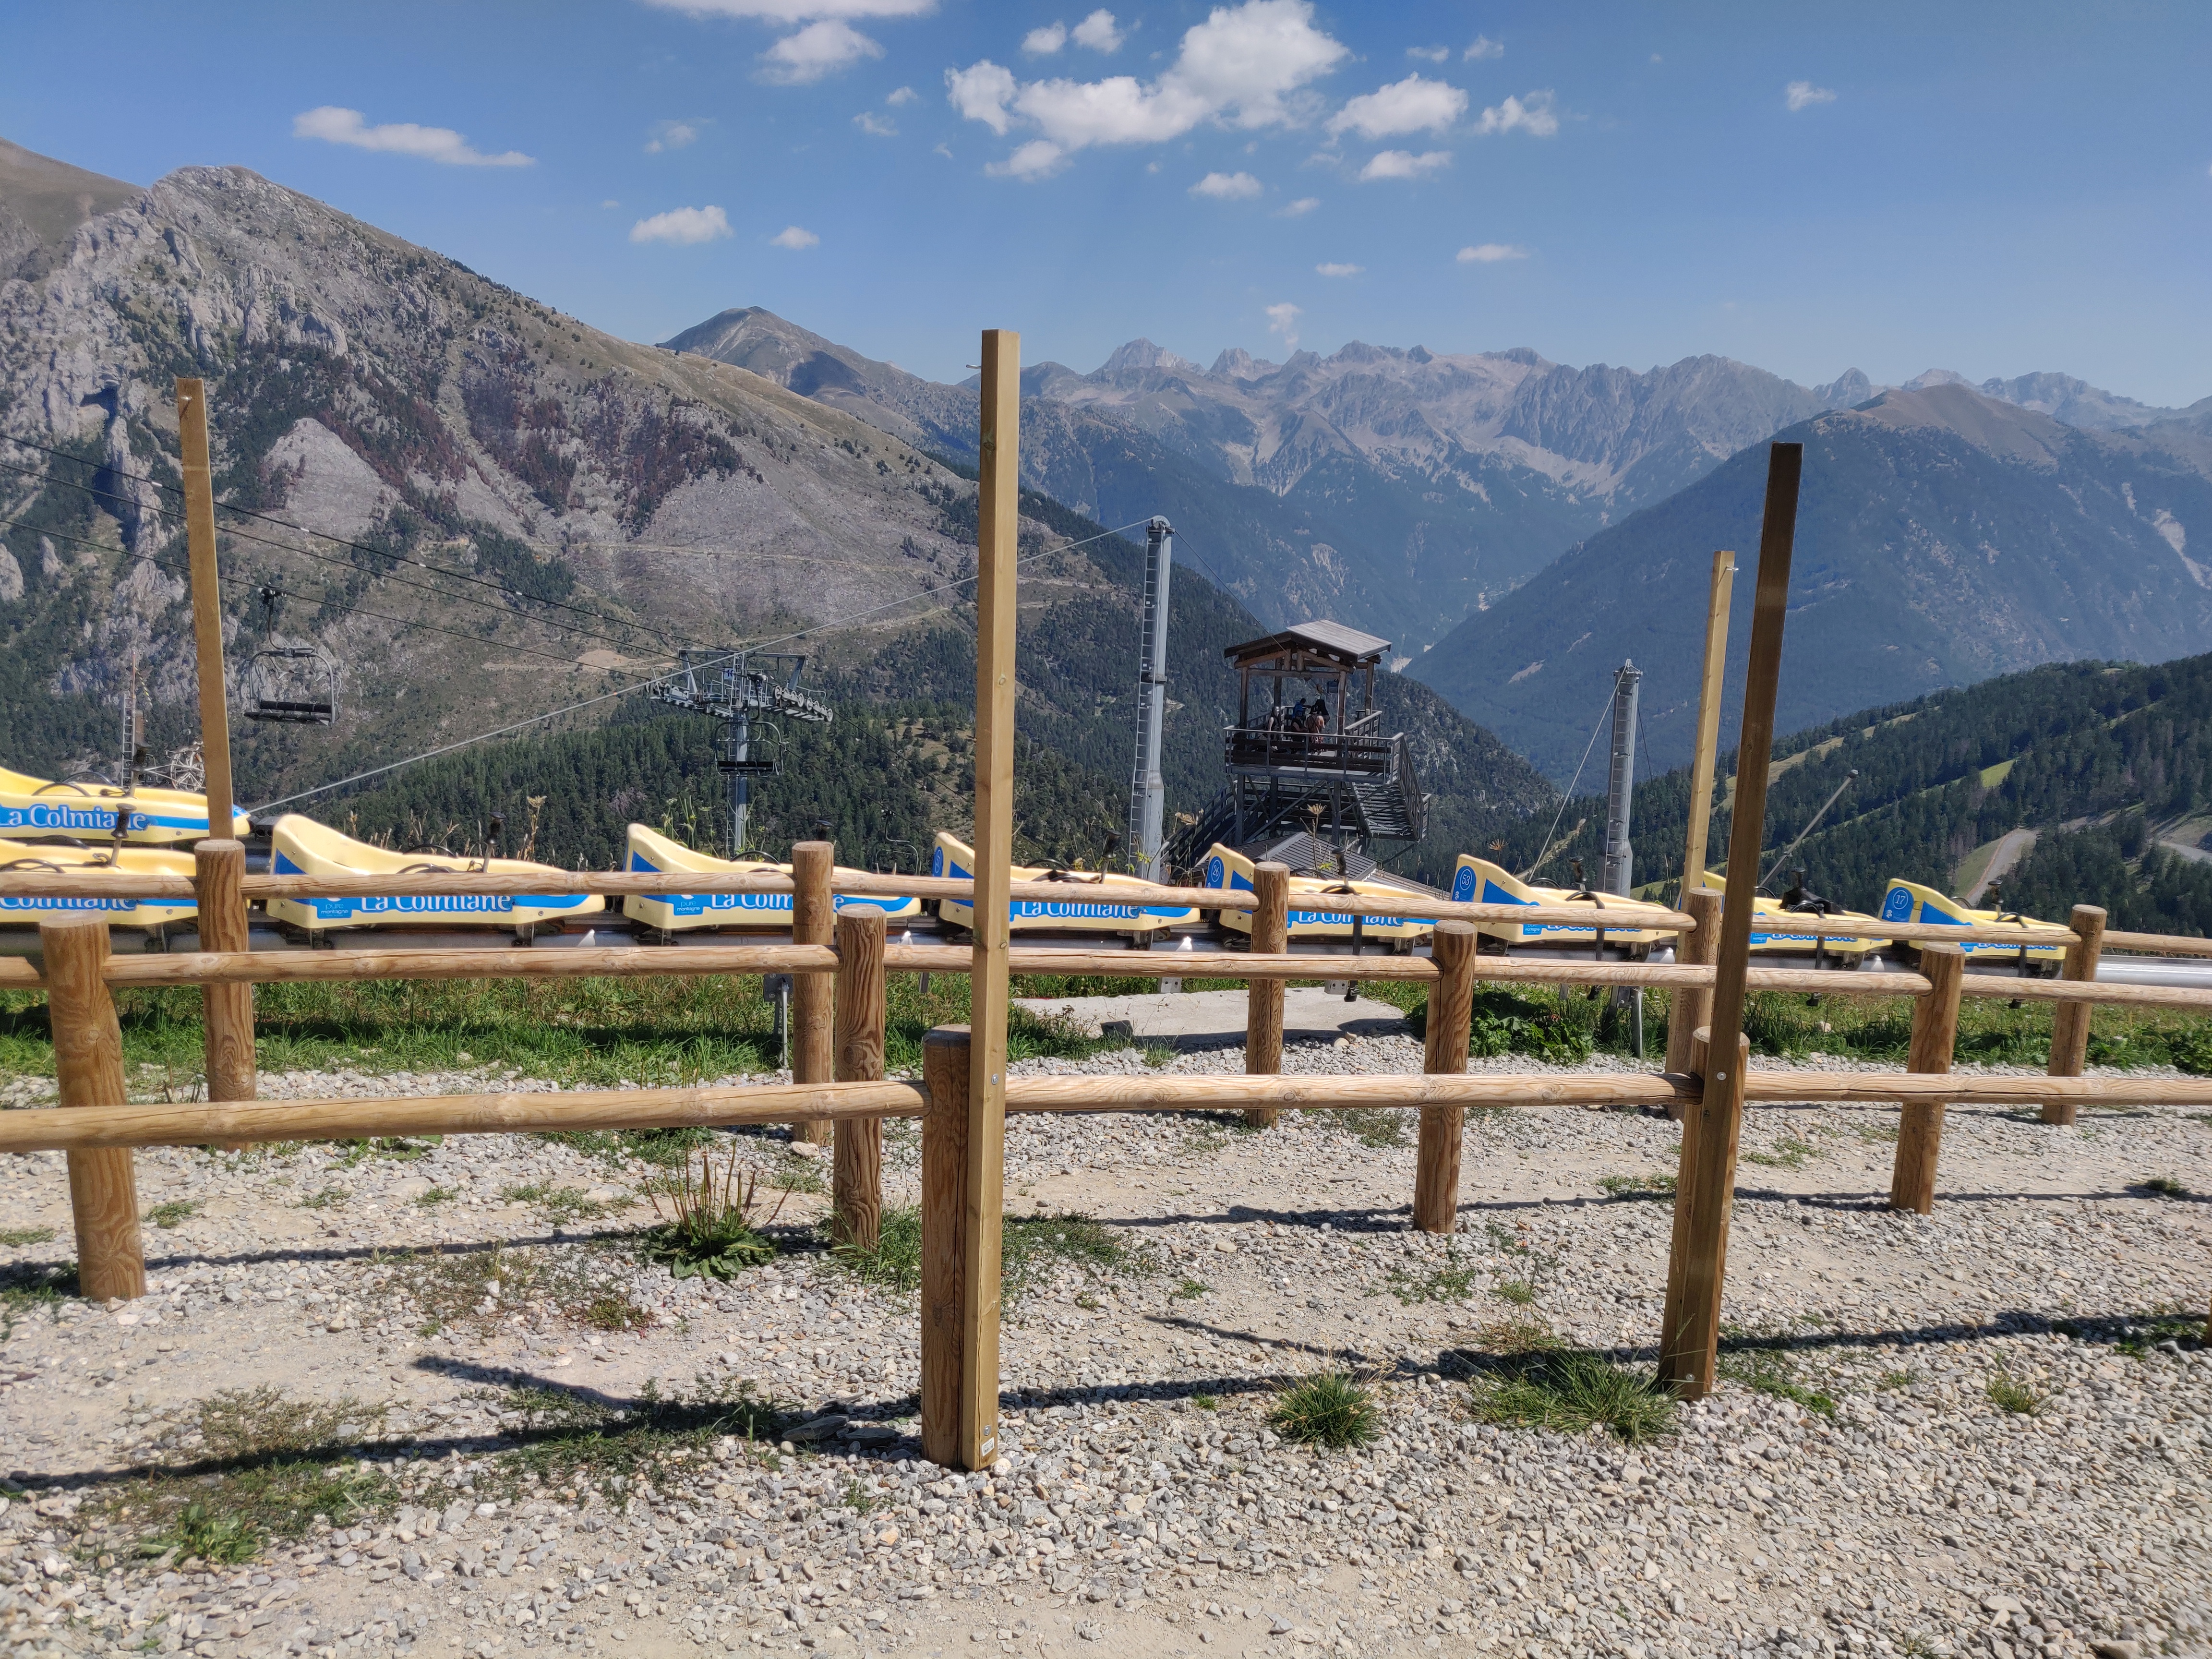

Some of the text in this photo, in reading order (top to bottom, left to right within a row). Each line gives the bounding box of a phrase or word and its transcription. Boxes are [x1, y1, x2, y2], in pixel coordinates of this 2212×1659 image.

[0, 811, 22, 825] a
[1213, 865, 1220, 877] 26
[1461, 874, 1470, 886] 53
[741, 894, 844, 911] Colme
[1894, 894, 1906, 905] 17
